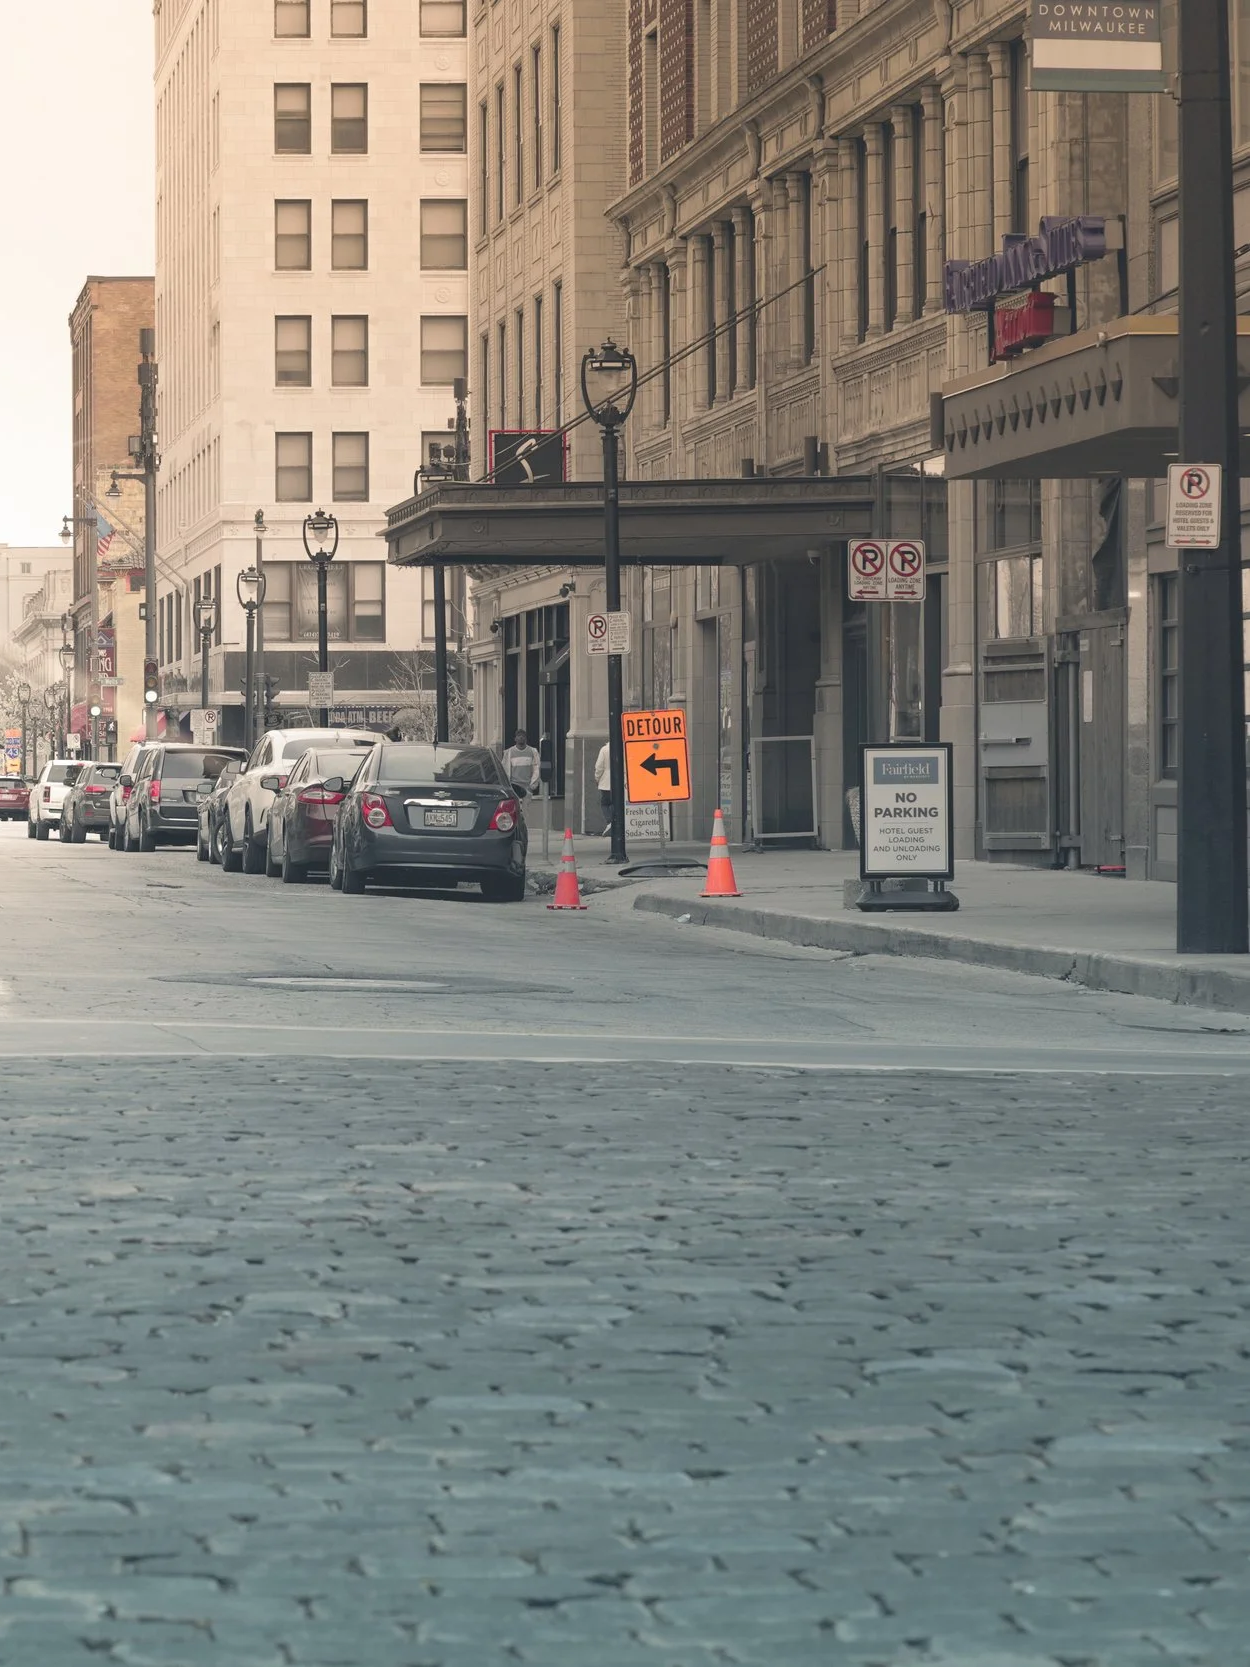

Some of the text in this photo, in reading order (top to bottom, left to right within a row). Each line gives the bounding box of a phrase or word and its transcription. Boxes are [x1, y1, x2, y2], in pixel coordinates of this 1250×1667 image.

[1039, 4, 1155, 19] DOWNTOWN
[1049, 20, 1146, 34] MILWAUKEE
[626, 716, 682, 737] DETOUR
[882, 763, 930, 776] Fairfield
[895, 792, 917, 804] NO
[625, 807, 644, 816] Fresh
[874, 807, 939, 818] PARKING
[879, 827, 934, 835] HOTEL GUEST
[888, 836, 925, 844] LOADING
[873, 845, 941, 853] AND UNLOADING
